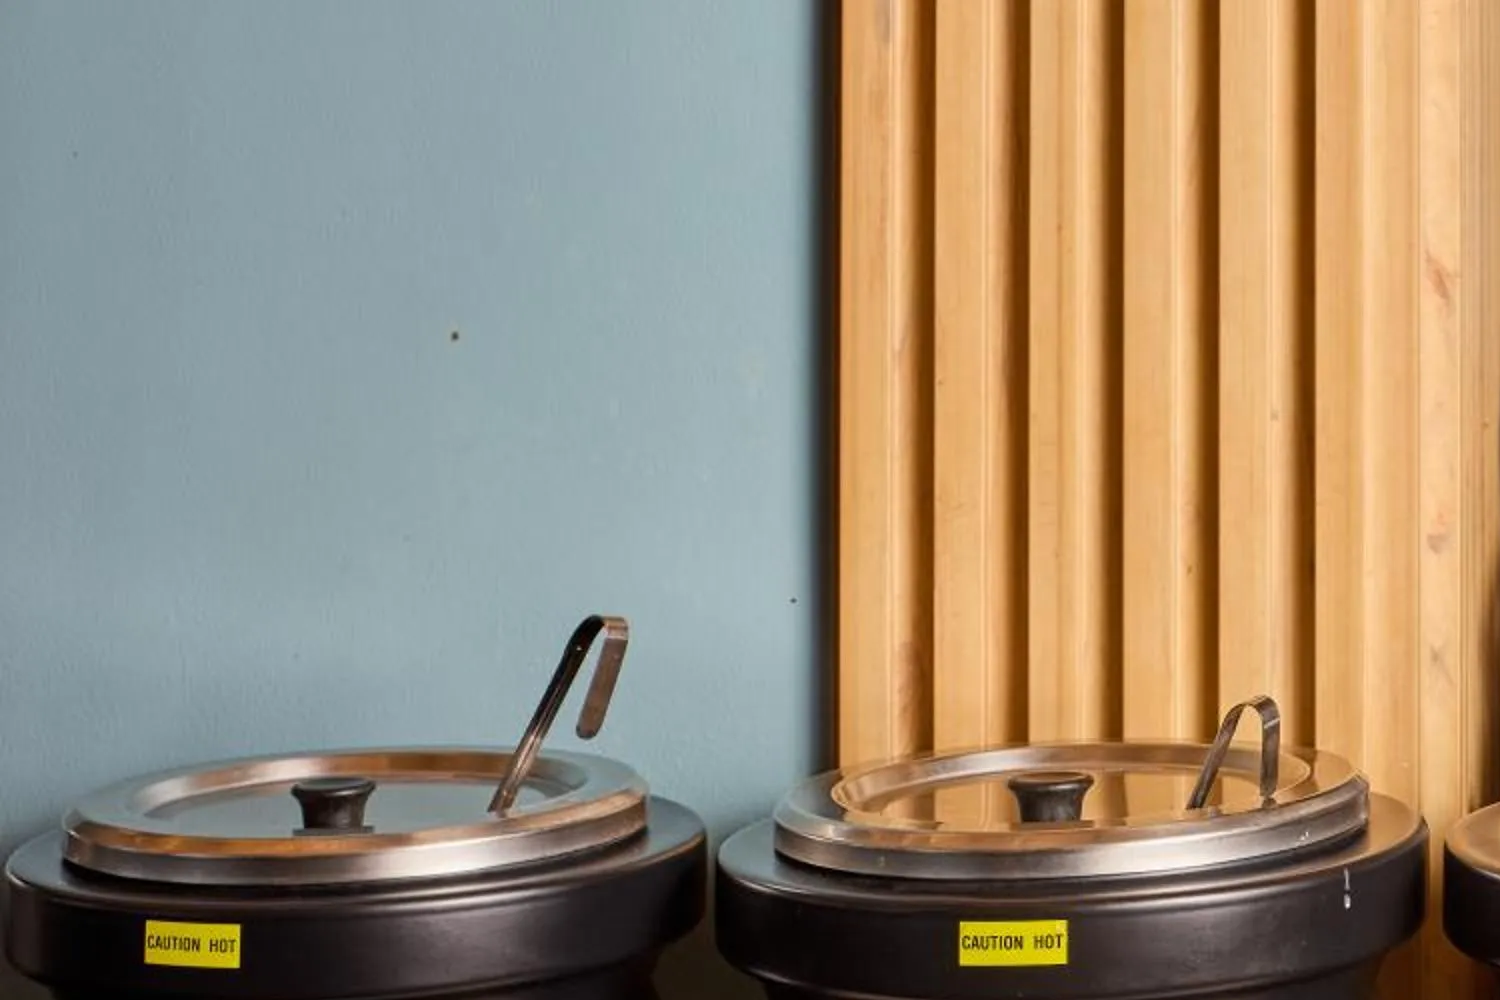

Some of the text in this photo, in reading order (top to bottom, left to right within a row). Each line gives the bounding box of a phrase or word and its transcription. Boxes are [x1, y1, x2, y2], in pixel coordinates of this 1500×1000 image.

[147, 935, 237, 953] CAUTION HOT
[961, 932, 1064, 951] CAUTION HOT
